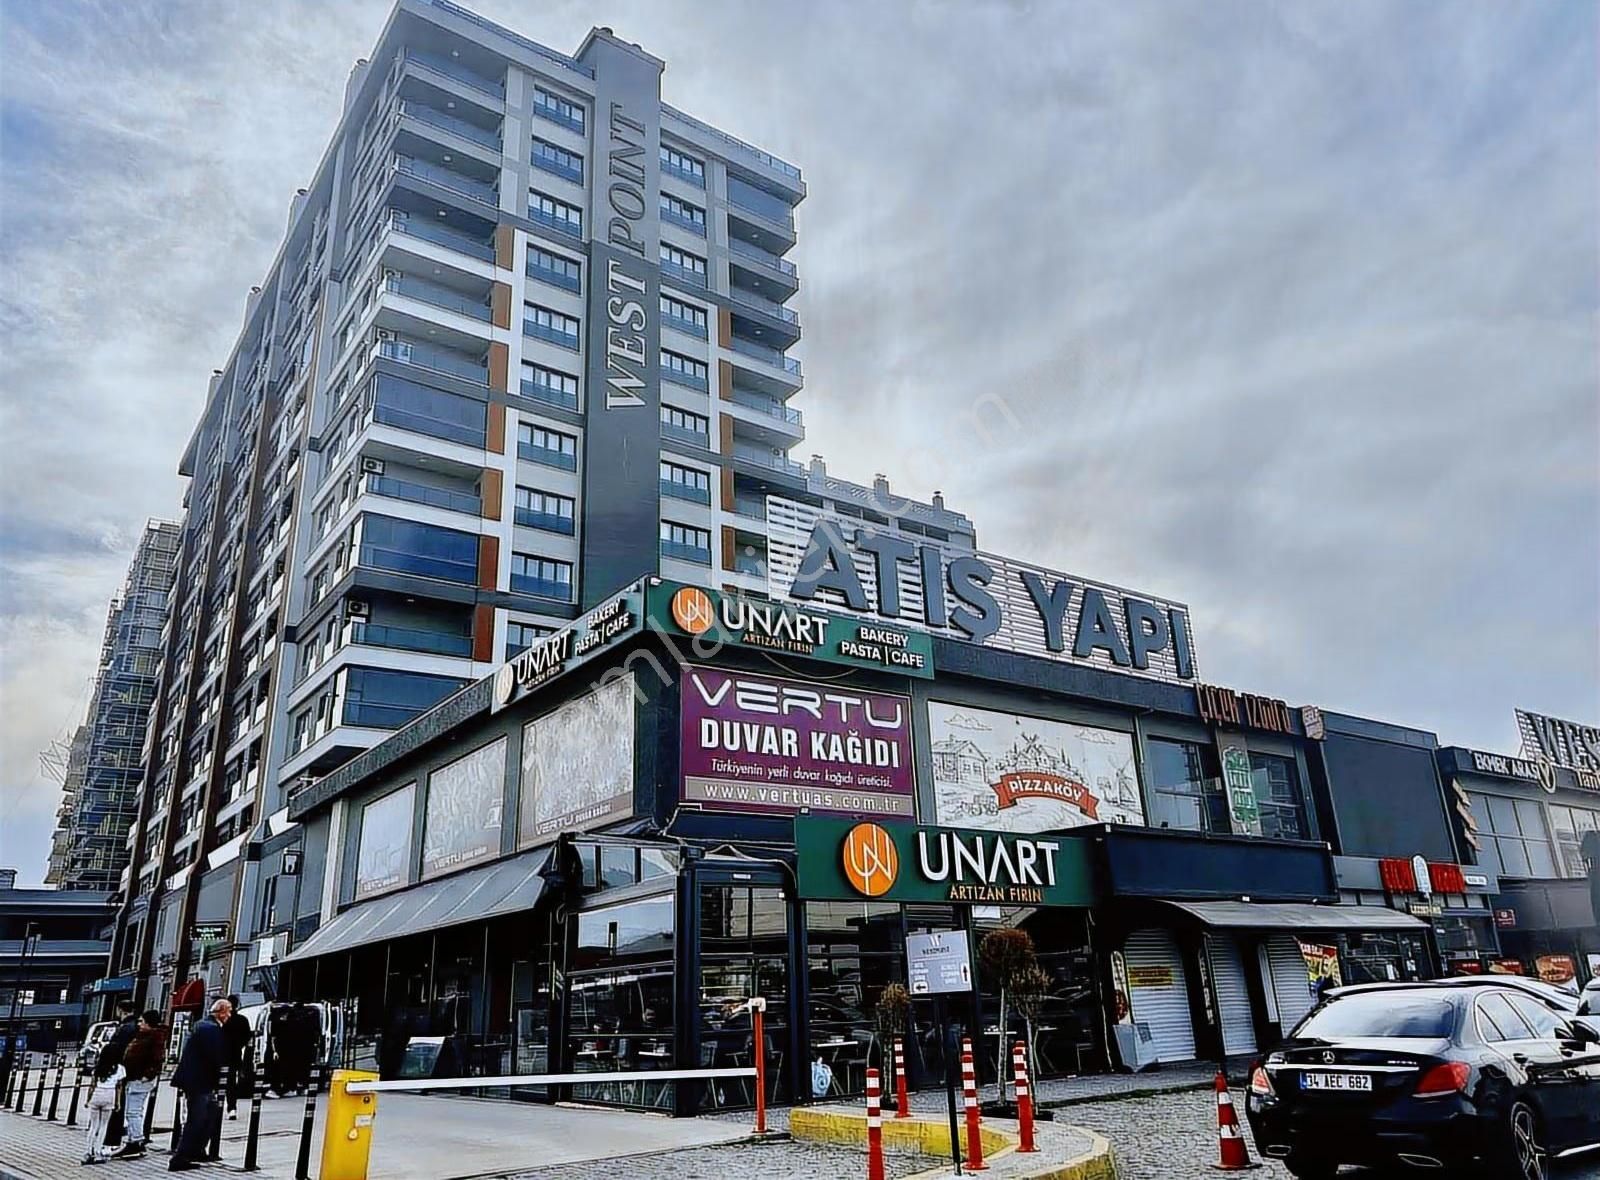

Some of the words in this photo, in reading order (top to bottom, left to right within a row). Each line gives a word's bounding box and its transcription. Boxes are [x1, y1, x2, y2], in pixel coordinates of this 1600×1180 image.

[608, 101, 648, 257] POINT
[605, 259, 648, 410] WEST
[587, 597, 621, 629] BAKERY
[788, 519, 1001, 644] ATIŞ
[1020, 571, 1194, 678] YAPI
[574, 633, 600, 656] PASTA
[606, 612, 629, 637] CAFE
[722, 598, 829, 645] UNART
[860, 626, 910, 648] BAKERY
[517, 625, 571, 684] UNART
[841, 640, 882, 661] PASTA
[891, 650, 924, 668] CAFE
[691, 673, 902, 729] VERTU
[701, 717, 799, 758] DUVAR
[811, 730, 900, 768] KAĞIDI
[711, 757, 763, 778] Türkiyenin
[767, 763, 789, 781] yerli
[793, 766, 821, 781] duvar
[704, 783, 900, 812] www.vertuas.com.tr
[918, 831, 1060, 886] UNART
[950, 884, 1004, 901] ARTIZAN
[1010, 887, 1043, 903] FIRIN
[1306, 1073, 1319, 1087] 34
[1324, 1075, 1342, 1088] AEC
[1348, 1075, 1369, 1089] 682
